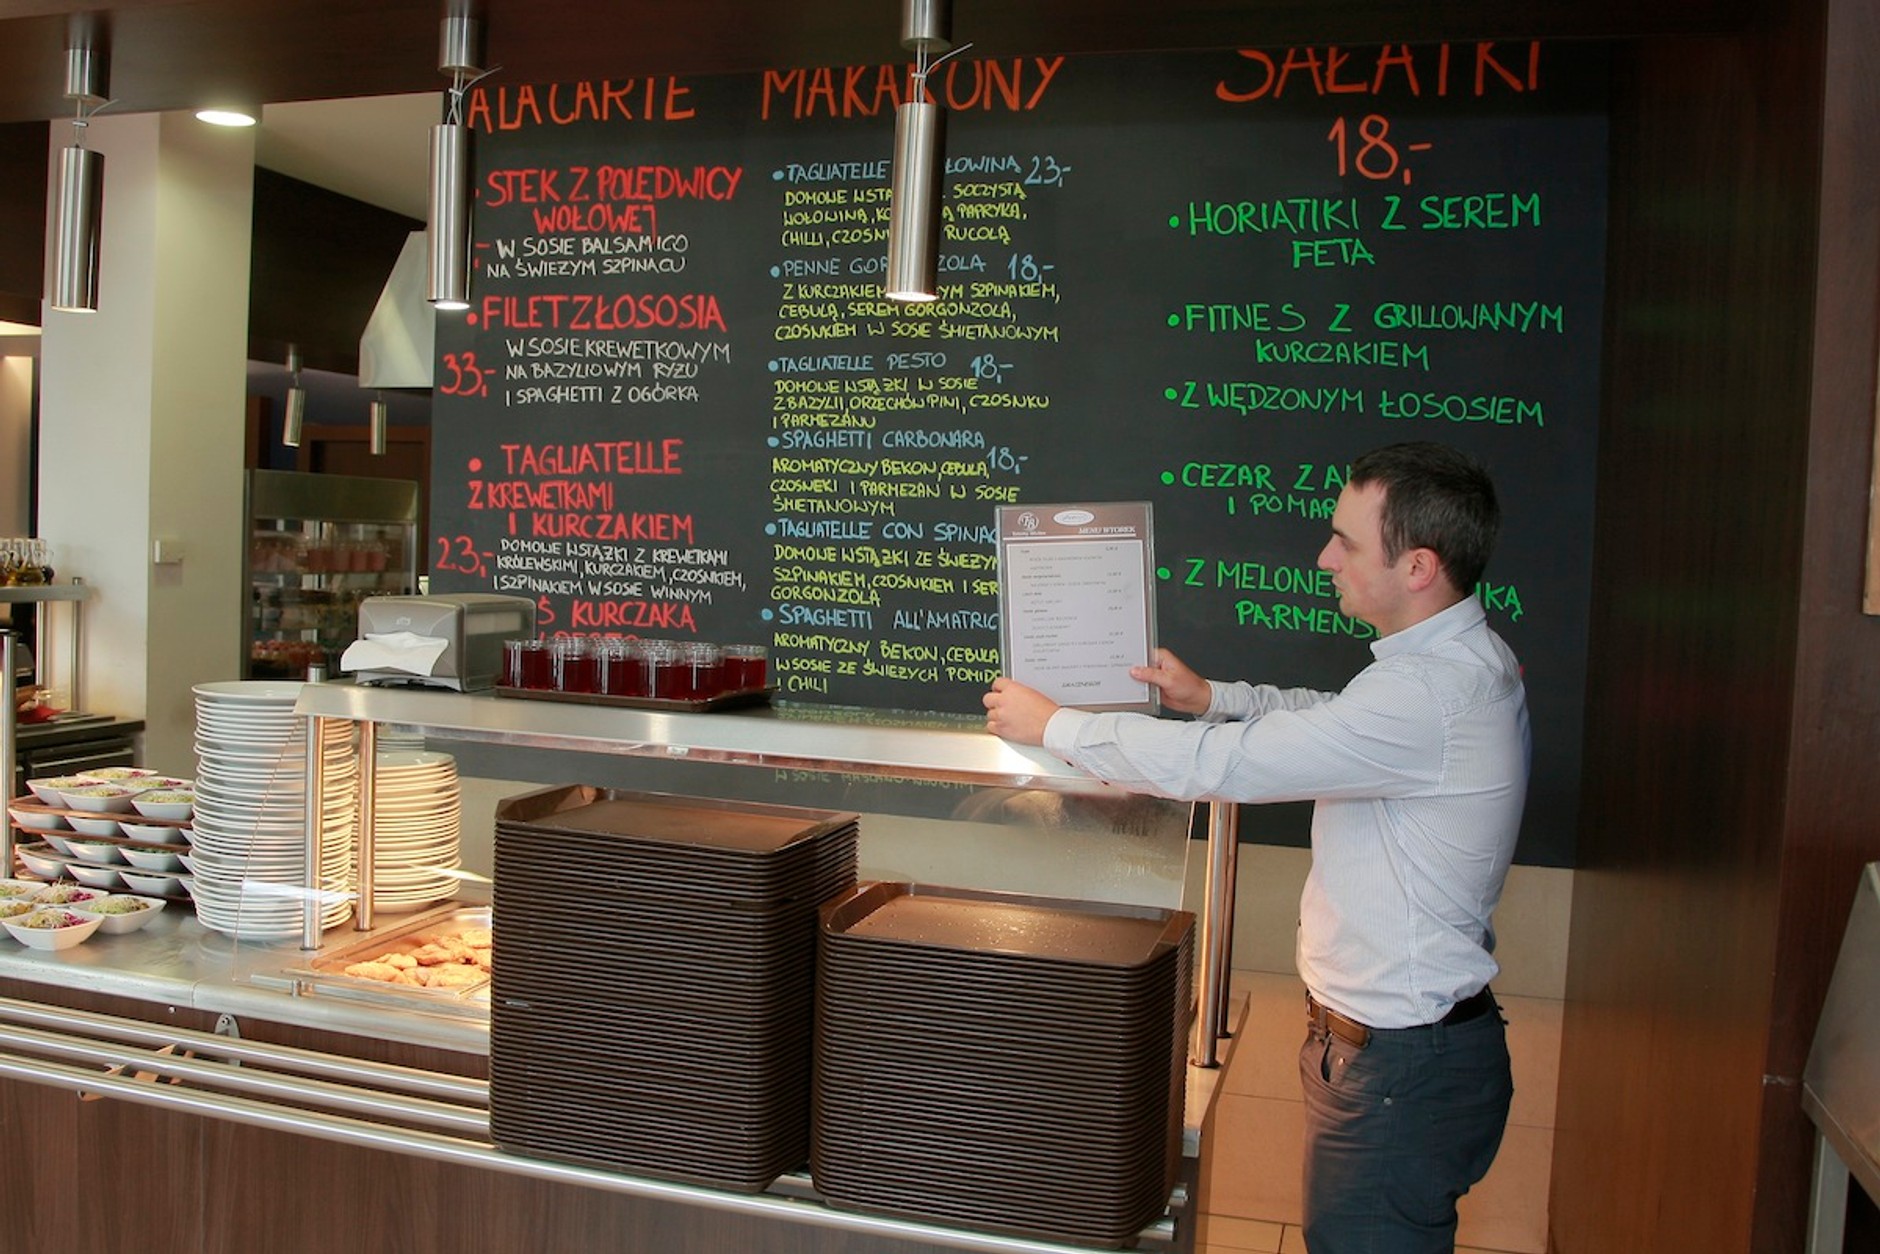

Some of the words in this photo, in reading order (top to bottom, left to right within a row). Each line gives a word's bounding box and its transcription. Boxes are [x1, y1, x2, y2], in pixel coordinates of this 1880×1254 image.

[468, 88, 493, 134] A
[787, 160, 891, 184] TAGLIATELLE
[945, 155, 1022, 174] ŁOWINĄ
[486, 169, 560, 207] STEK
[784, 188, 848, 207] DOMOWE
[533, 203, 657, 244] WOŁOWEJ
[1189, 198, 1360, 236] HORIATIKI
[1381, 195, 1407, 231] Z
[1420, 192, 1541, 230] SEREM
[495, 238, 516, 260] W
[523, 237, 576, 257] SOSIE
[582, 234, 689, 256] BALSAMICO
[1291, 237, 1376, 269] FETA
[487, 263, 511, 279] NA
[602, 256, 686, 275] SZPINACU
[783, 258, 842, 278] PENNE
[783, 284, 795, 299] Z
[482, 295, 568, 331] FILET
[569, 295, 592, 330] Z
[594, 294, 727, 332] ŁOSOSIA
[847, 302, 899, 318] SEREM
[1328, 304, 1352, 333] Z
[1373, 301, 1563, 334] GRILLOWANYM
[867, 322, 885, 337] W
[891, 321, 933, 338] SOSIE
[938, 320, 1060, 343] ŚMIETANOWYM
[506, 338, 526, 358] W
[528, 337, 583, 358] SOSIE
[584, 339, 731, 364] KREWETKOWYM
[778, 356, 874, 373] TAGLIATELLE
[886, 352, 946, 372] PESTO
[1255, 339, 1430, 371] KURCZAKIEM
[506, 364, 528, 381] NA
[531, 361, 642, 380] BAZYLIOWYM
[506, 390, 511, 407] I
[516, 385, 602, 404] SPAGHETTI
[611, 385, 622, 403] Z
[628, 381, 699, 403] OGÓRKA
[774, 378, 840, 395] DOMOWE
[918, 377, 933, 392] W
[938, 376, 979, 391] SOSIE
[773, 396, 785, 411] Z
[969, 392, 1050, 410] CZOSNKU
[1180, 381, 1200, 408] Z
[1206, 382, 1364, 416] WĘDZONYM
[1379, 390, 1544, 427] ŁOSOSIEM
[781, 430, 872, 450] SPAGHETTI
[882, 430, 985, 449] CARBONARA
[501, 439, 683, 475] TAGLIATELLE
[772, 457, 879, 478] AROMATYCZNY
[1181, 462, 1276, 489] CEZAR
[1294, 464, 1315, 492] Z
[468, 480, 483, 509] Z
[488, 480, 614, 511] KREWETKAMI
[860, 479, 941, 498] PARMEZAN
[950, 484, 967, 500] W
[974, 485, 1021, 503] SOSIE
[1227, 496, 1236, 516] I
[1250, 495, 1337, 519] POMAR
[508, 514, 517, 536] I
[532, 512, 694, 544] KURCZAKIEM
[778, 517, 873, 540] TAGLIATELLE
[882, 522, 923, 540] CON
[501, 539, 562, 555] DOMOWE
[634, 547, 646, 563] Z
[652, 549, 728, 567] KREWETKAMI
[774, 543, 837, 562] DOMOWE
[915, 550, 933, 567] ZE
[493, 576, 498, 591] I
[501, 575, 583, 595] SZPINAKIEM
[588, 581, 600, 596] W
[602, 581, 643, 598] SOSIE
[650, 585, 712, 605] WINNYM
[963, 579, 968, 593] I
[1184, 559, 1206, 588] Z
[1216, 560, 1337, 598] MELONE
[571, 598, 697, 633] KURCZAKA
[779, 603, 872, 630] SPAGHETTI
[893, 608, 999, 631] ALL'AMATRIC
[1235, 600, 1381, 639] PARMENS
[773, 632, 870, 657] AROMATYCZNY
[776, 658, 790, 672] W
[791, 658, 831, 674] SOSIE
[837, 661, 858, 675] ZE
[787, 675, 828, 694] CHILI
